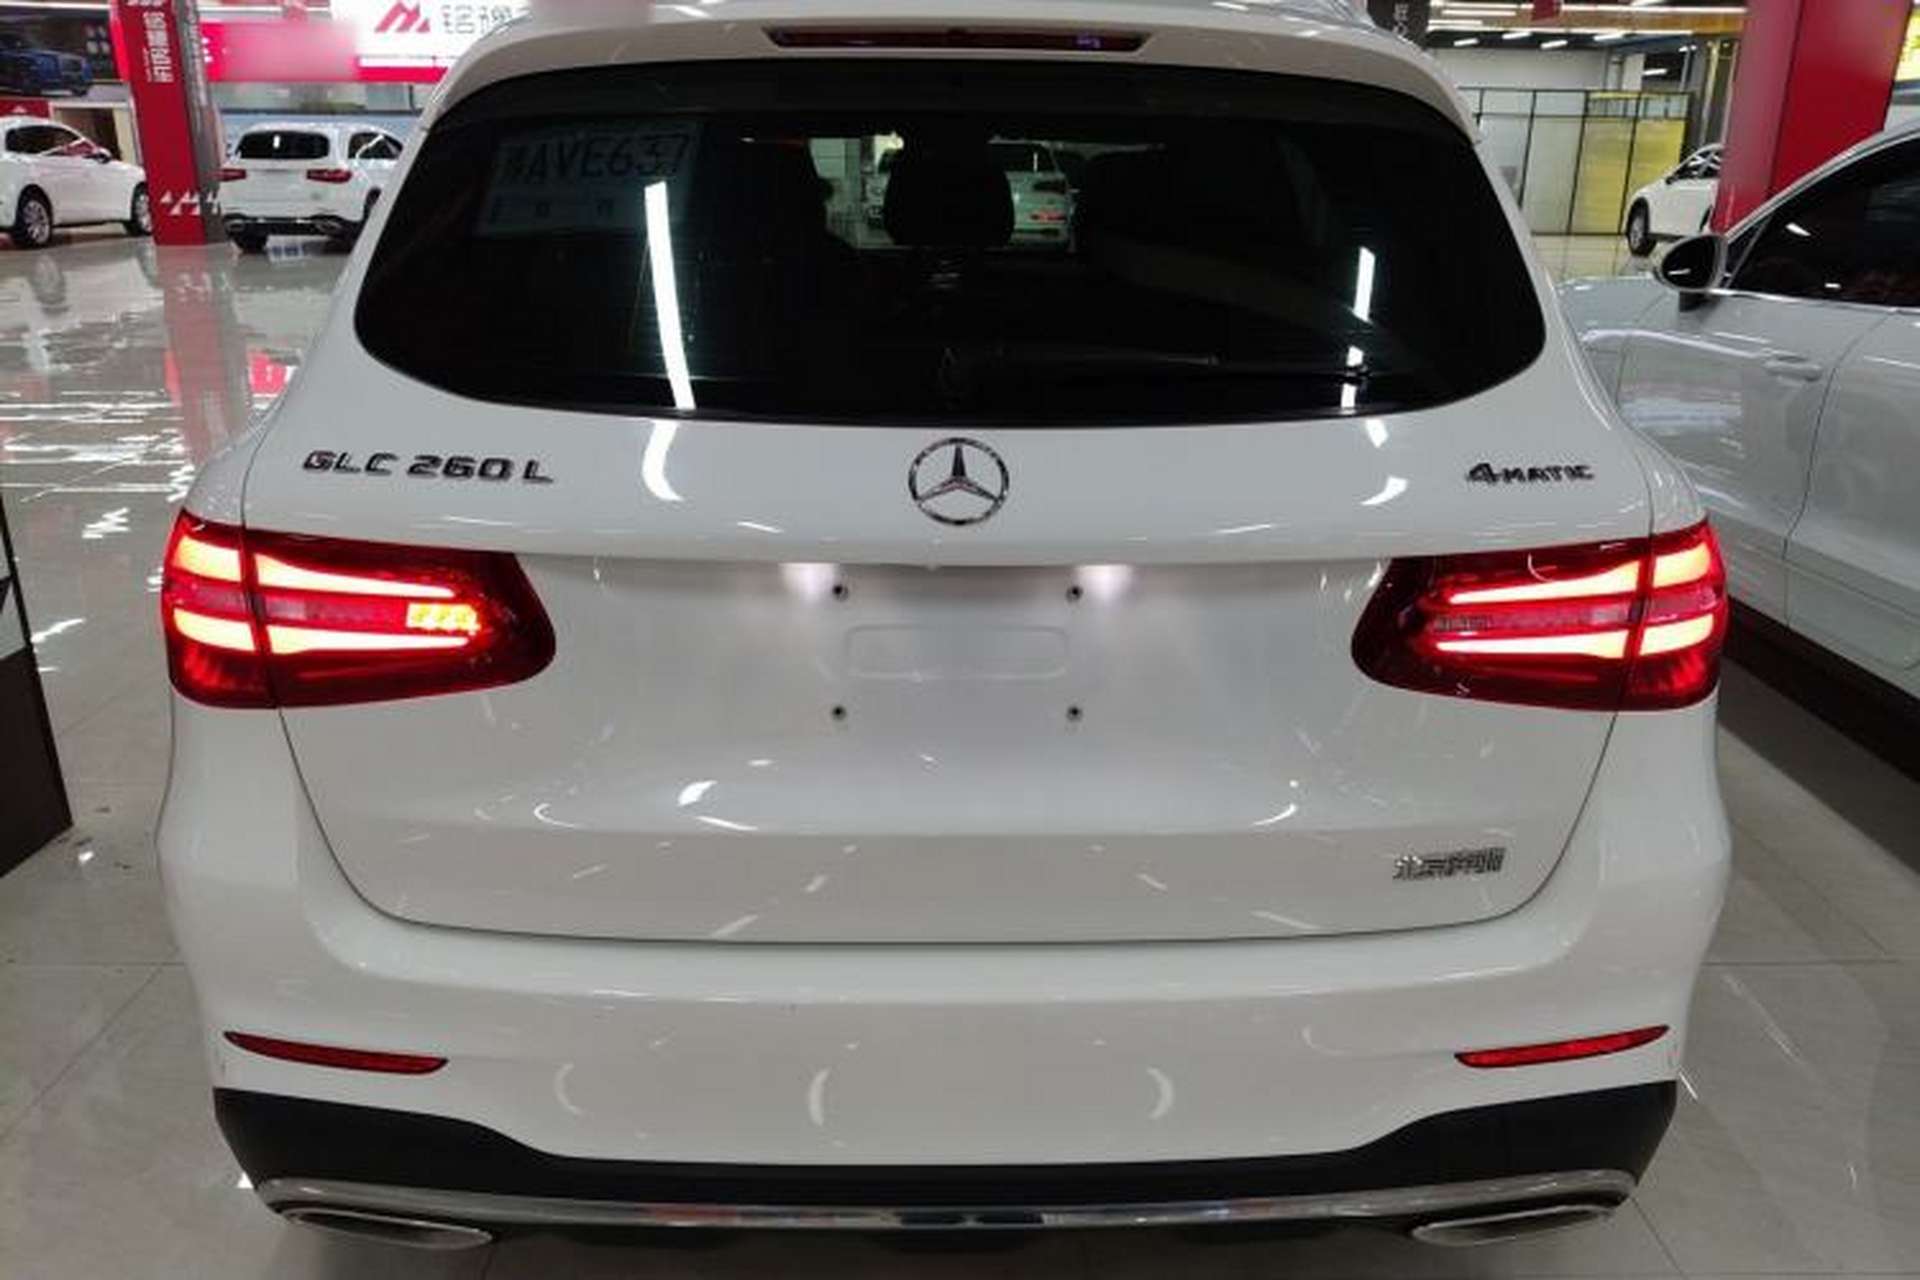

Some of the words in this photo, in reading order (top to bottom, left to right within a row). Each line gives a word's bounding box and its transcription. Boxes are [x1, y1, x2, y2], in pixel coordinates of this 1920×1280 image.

[303, 449, 399, 478] GLC
[406, 454, 515, 483] 260
[521, 458, 555, 485] L
[1467, 462, 1595, 485] 4MATIC
